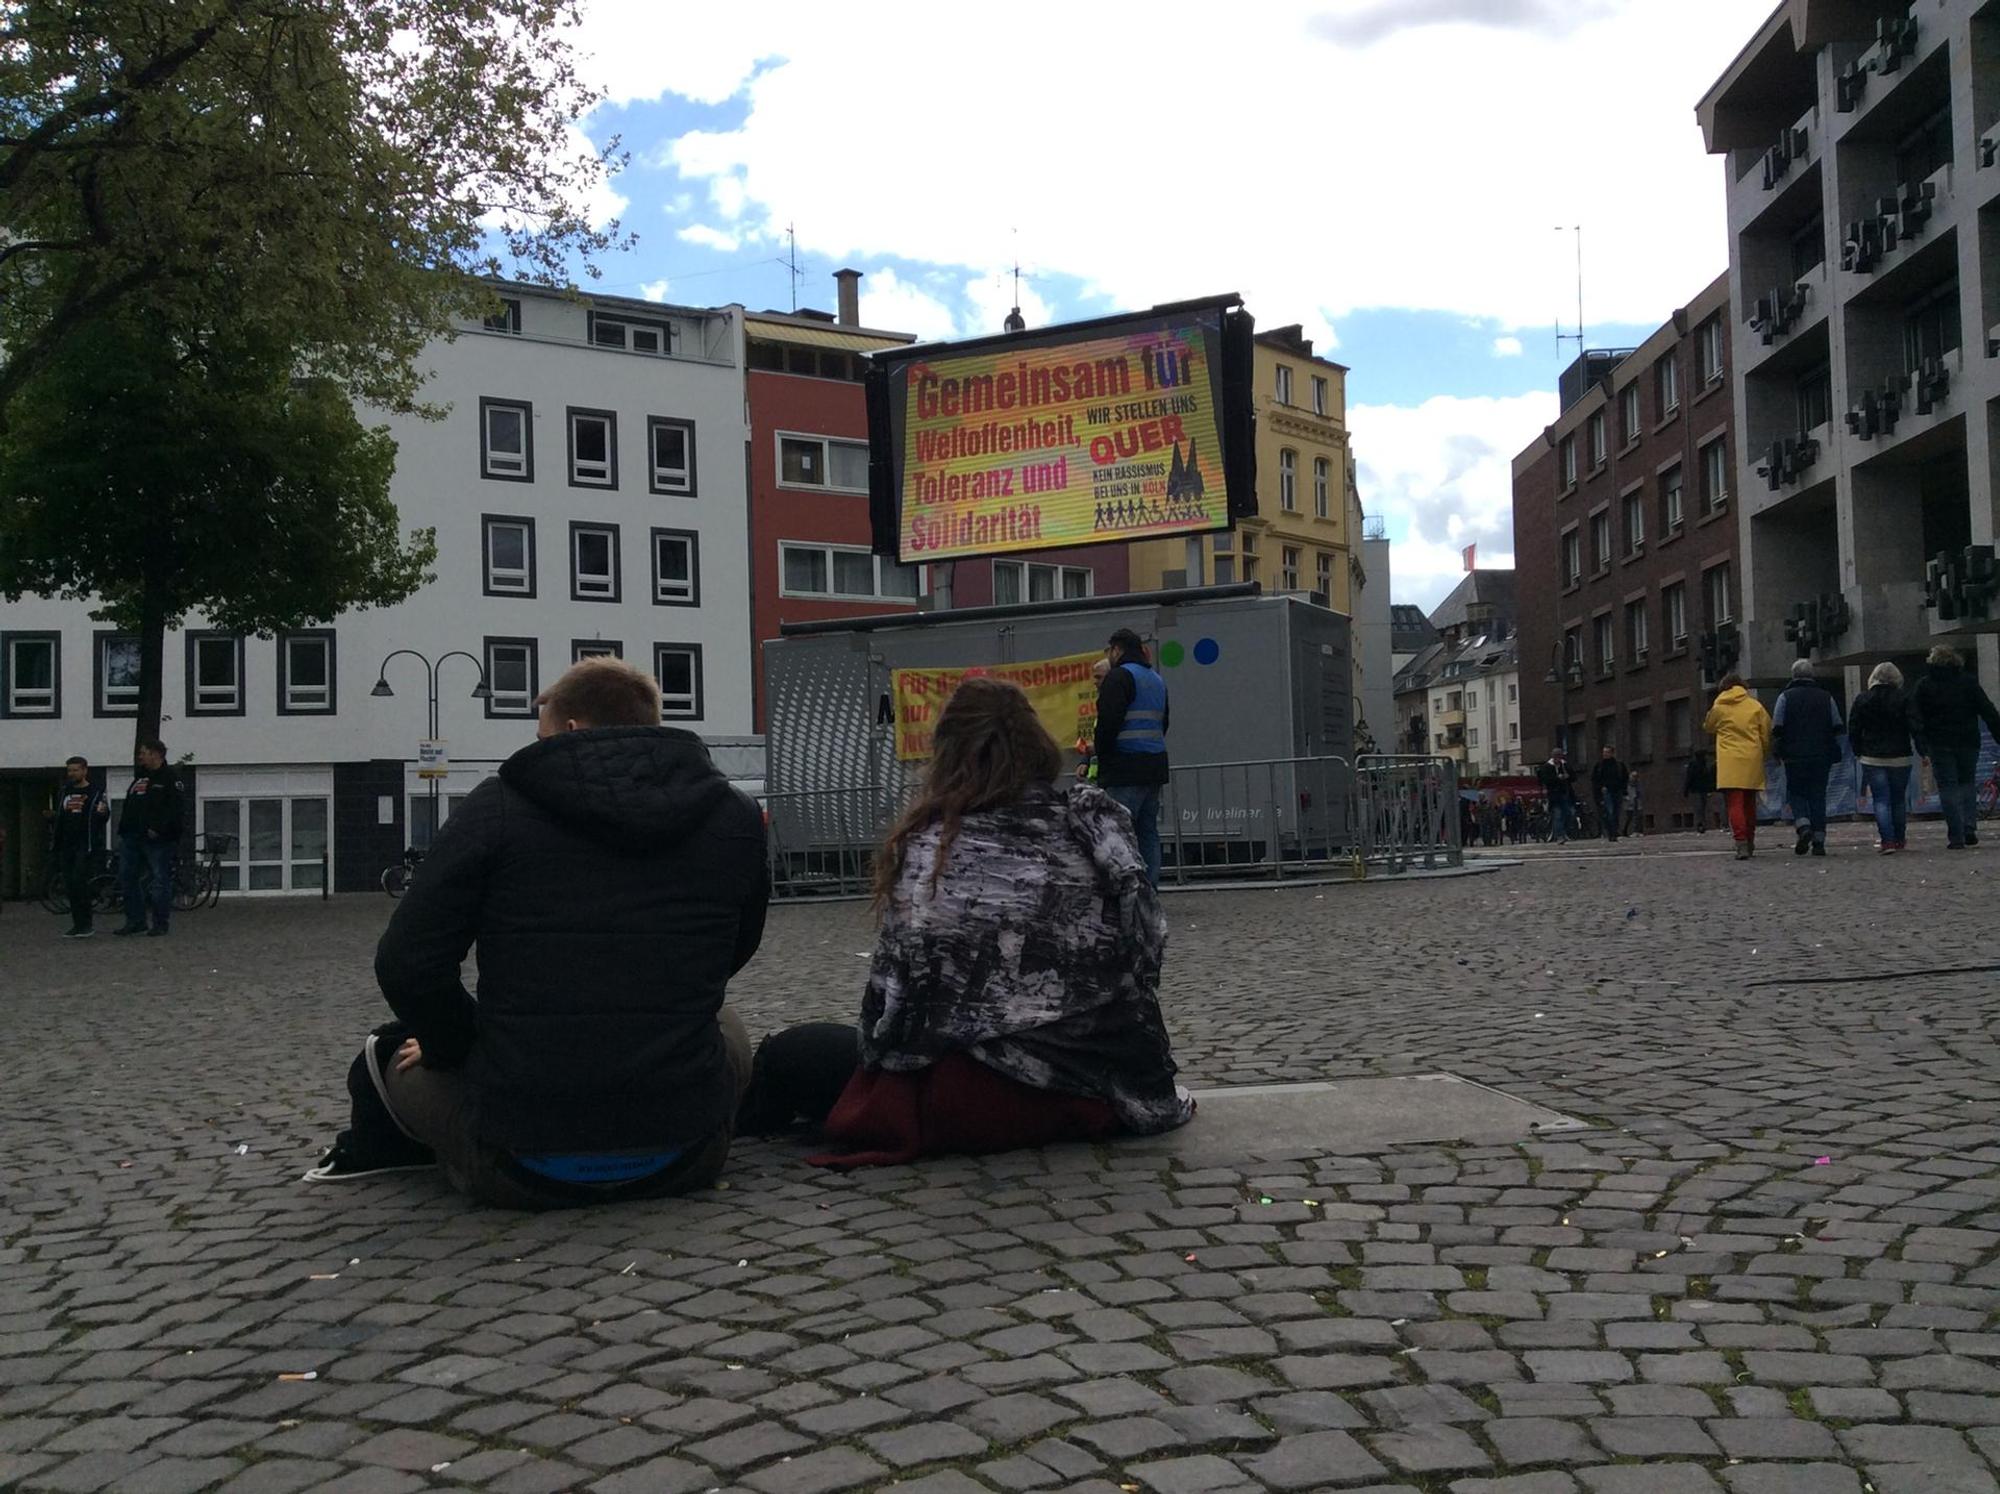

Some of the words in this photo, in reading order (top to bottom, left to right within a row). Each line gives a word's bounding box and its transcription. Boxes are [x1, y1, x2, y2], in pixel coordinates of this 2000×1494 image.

[917, 354, 1130, 421] Gemeinsam
[1141, 341, 1193, 391] für
[1087, 406, 1110, 425] WIR
[1115, 399, 1167, 422] STELLEN
[1172, 395, 1198, 414] UNS
[914, 414, 1081, 463] Weltoffenheit,
[1089, 413, 1188, 465] QUER
[913, 467, 1014, 505] Toleranz
[1022, 455, 1067, 493] und
[1115, 463, 1166, 480] RASSISMUS
[911, 503, 1042, 550] Solidarität
[1182, 808, 1198, 823] by
